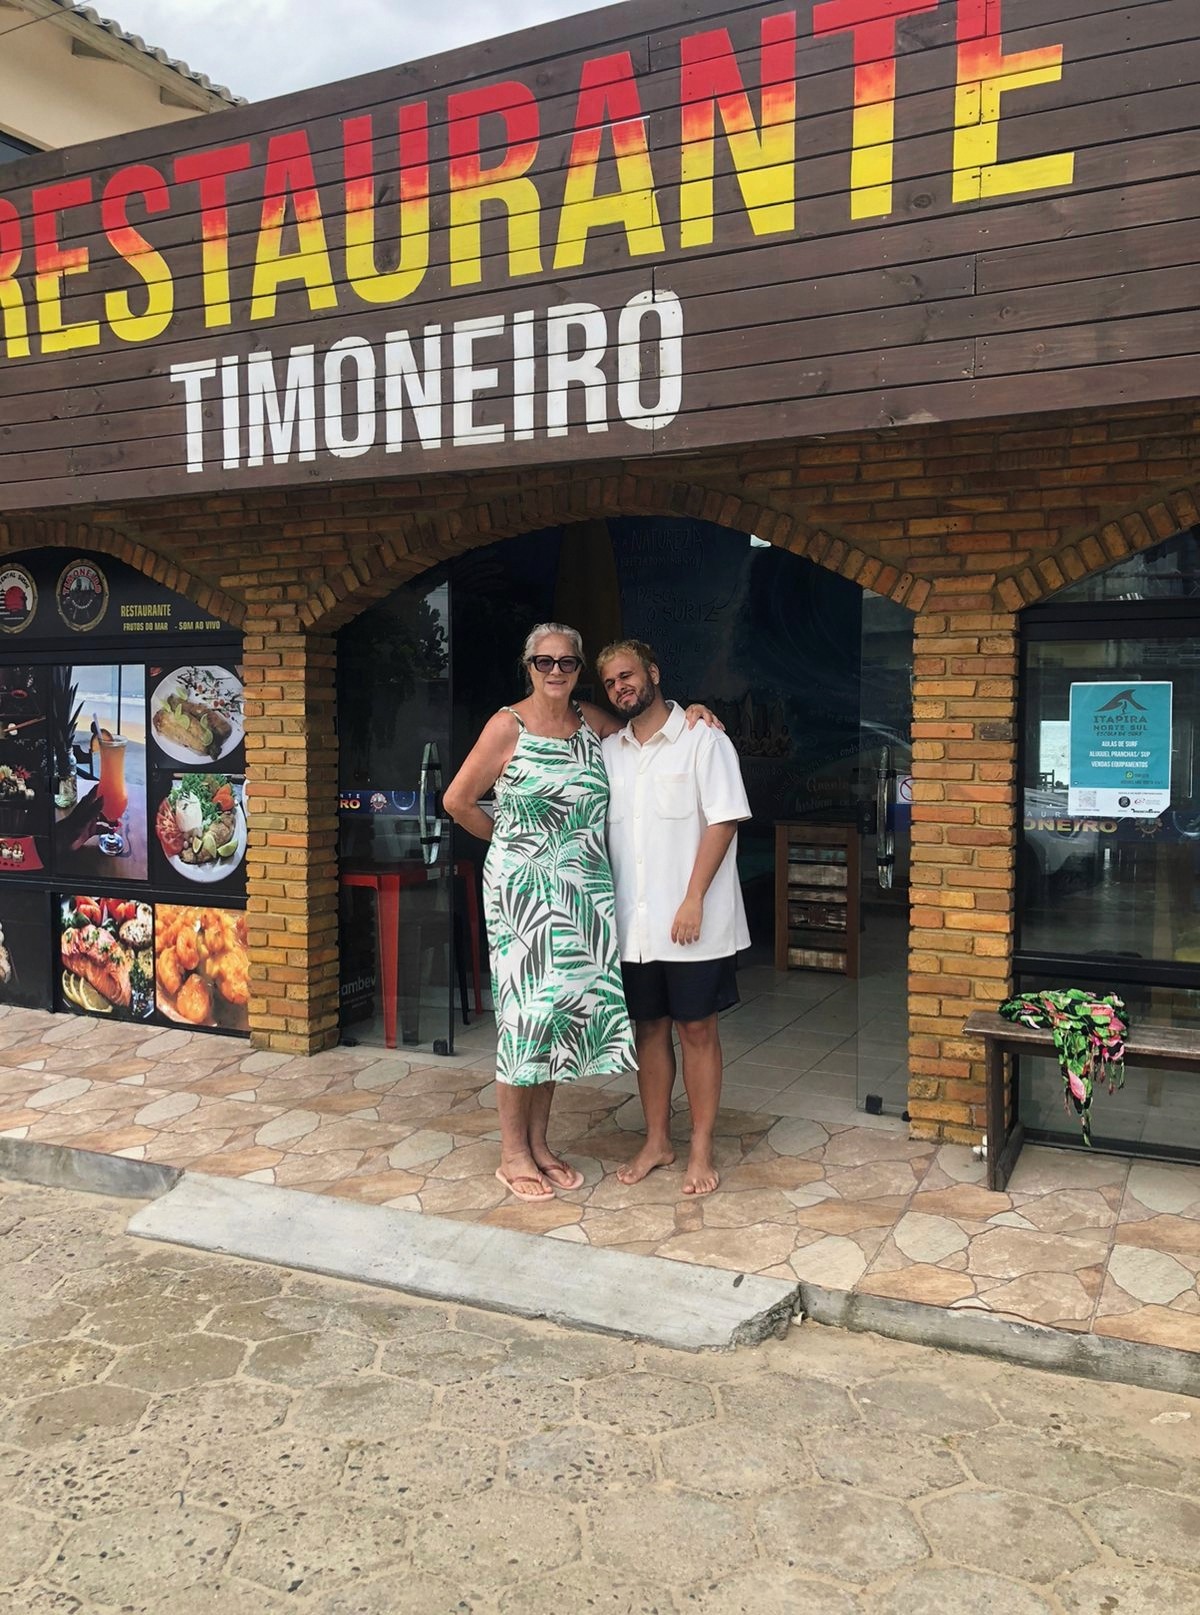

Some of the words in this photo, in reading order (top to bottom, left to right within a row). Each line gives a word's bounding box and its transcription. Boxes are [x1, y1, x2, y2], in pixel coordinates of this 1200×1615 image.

[170, 290, 684, 473] TIMONEIRO
[120, 604, 171, 618] RESTAURANTE
[123, 622, 144, 631] FRUTOS
[154, 622, 168, 631] MAR
[178, 621, 193, 630] SOM
[195, 621, 204, 630] AO
[205, 621, 221, 630] VIVO
[1094, 715, 1147, 723] ITAPIRA
[341, 976, 376, 996] ambev
